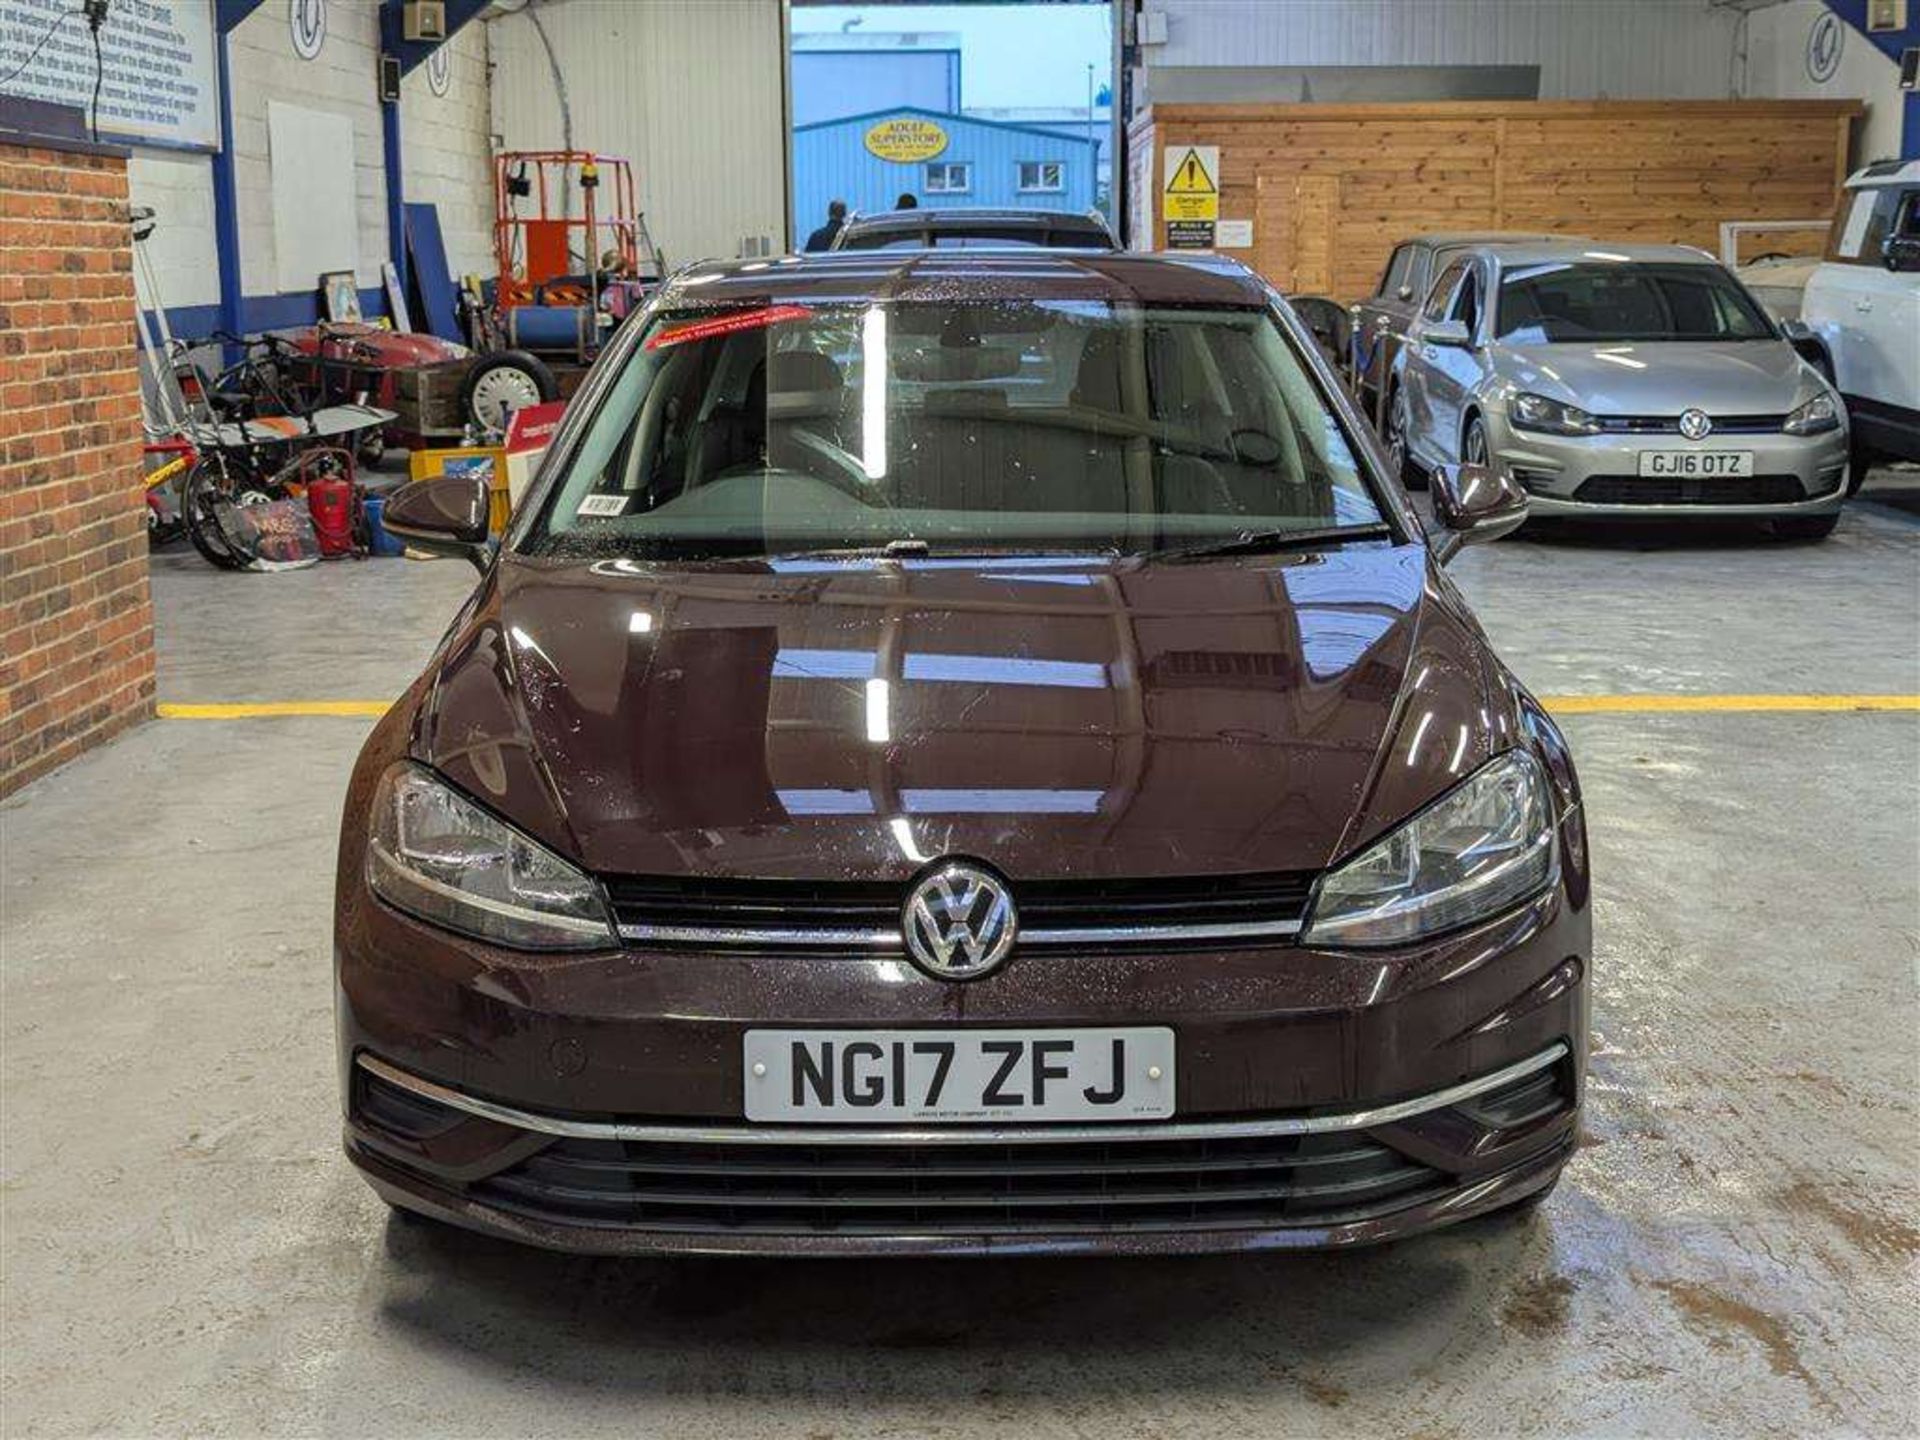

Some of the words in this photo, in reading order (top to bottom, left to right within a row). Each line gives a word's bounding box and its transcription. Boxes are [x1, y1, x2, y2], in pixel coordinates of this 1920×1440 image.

[1652, 455, 1697, 473] GJ16
[1702, 455, 1741, 473] OTZ
[791, 1041, 956, 1107] NG17
[981, 1039, 1125, 1106] ZFJ
